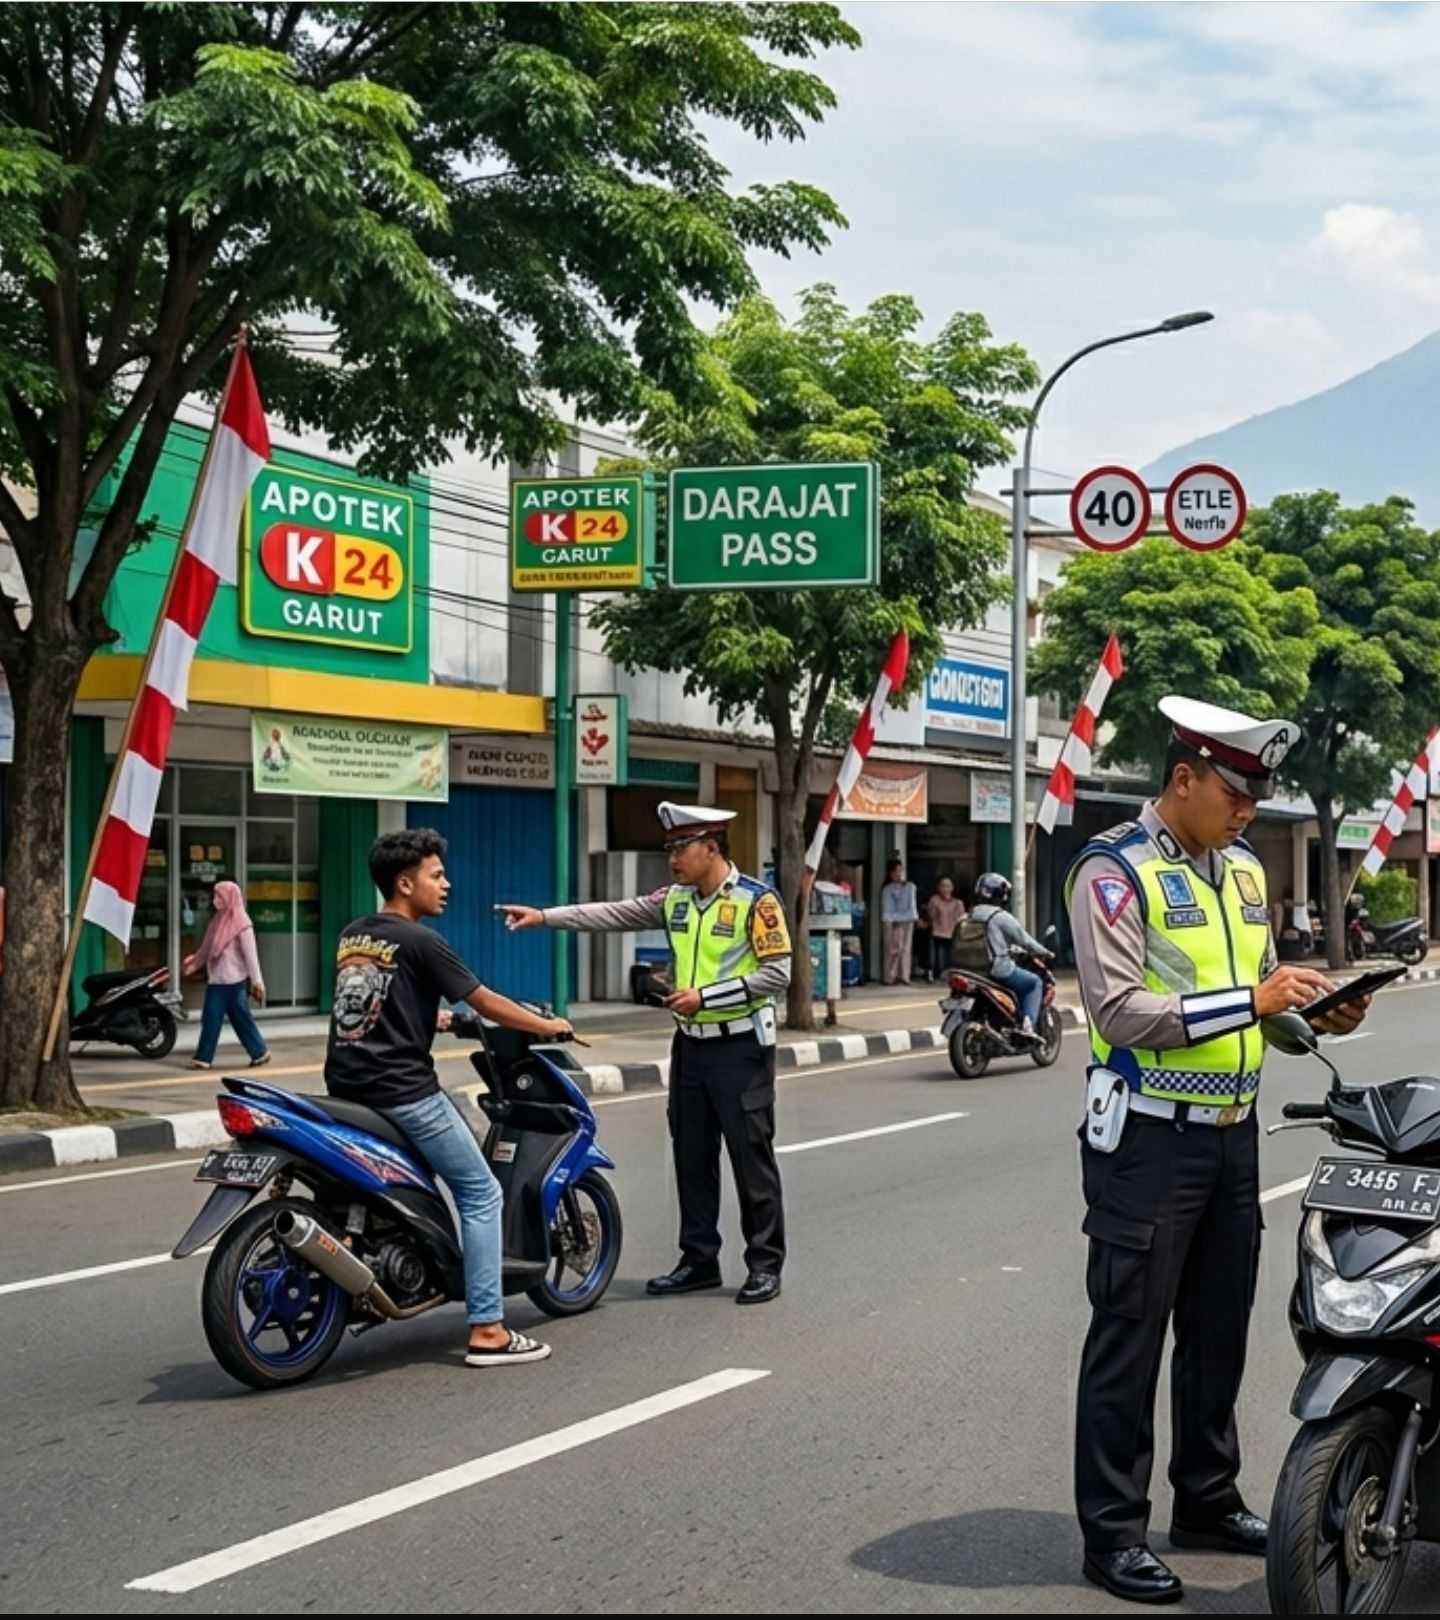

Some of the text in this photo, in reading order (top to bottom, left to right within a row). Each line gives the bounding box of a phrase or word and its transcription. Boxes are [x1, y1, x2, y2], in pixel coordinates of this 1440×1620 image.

[260, 481, 404, 537] APOTEK
[522, 487, 630, 508] APOTEK
[683, 483, 857, 521] DARAJAT
[1084, 490, 1136, 527] 40
[1178, 490, 1233, 509] ETLE
[541, 513, 619, 542] K 24
[286, 531, 394, 590] K 24
[542, 547, 613, 563] GARUT
[721, 530, 817, 567] PASS
[282, 598, 383, 635] GARUT
